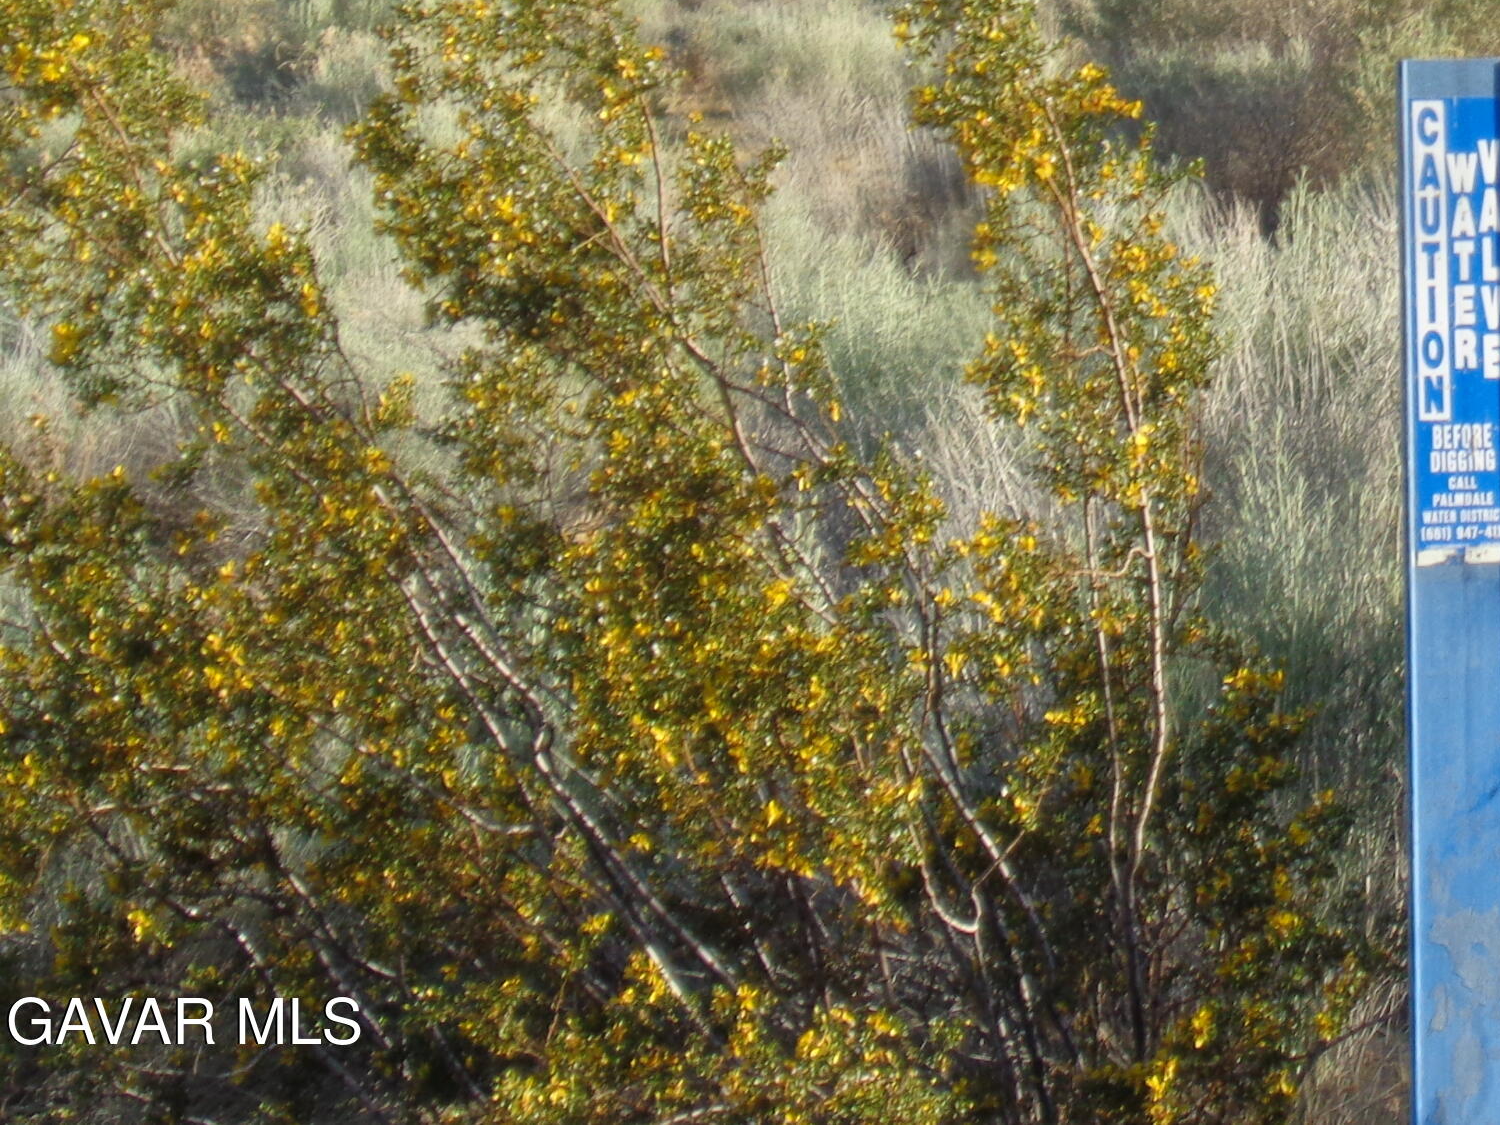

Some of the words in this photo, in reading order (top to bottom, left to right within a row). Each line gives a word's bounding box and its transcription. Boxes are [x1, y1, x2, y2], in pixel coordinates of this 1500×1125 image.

[1416, 106, 1445, 414] CAUTION
[1446, 152, 1478, 370] WATER
[1432, 422, 1493, 450] BEFORE
[1430, 449, 1497, 473] DIGGING
[1448, 475, 1478, 490] CALL
[1432, 491, 1495, 507] PALMDALE
[1422, 509, 1457, 525] WATER
